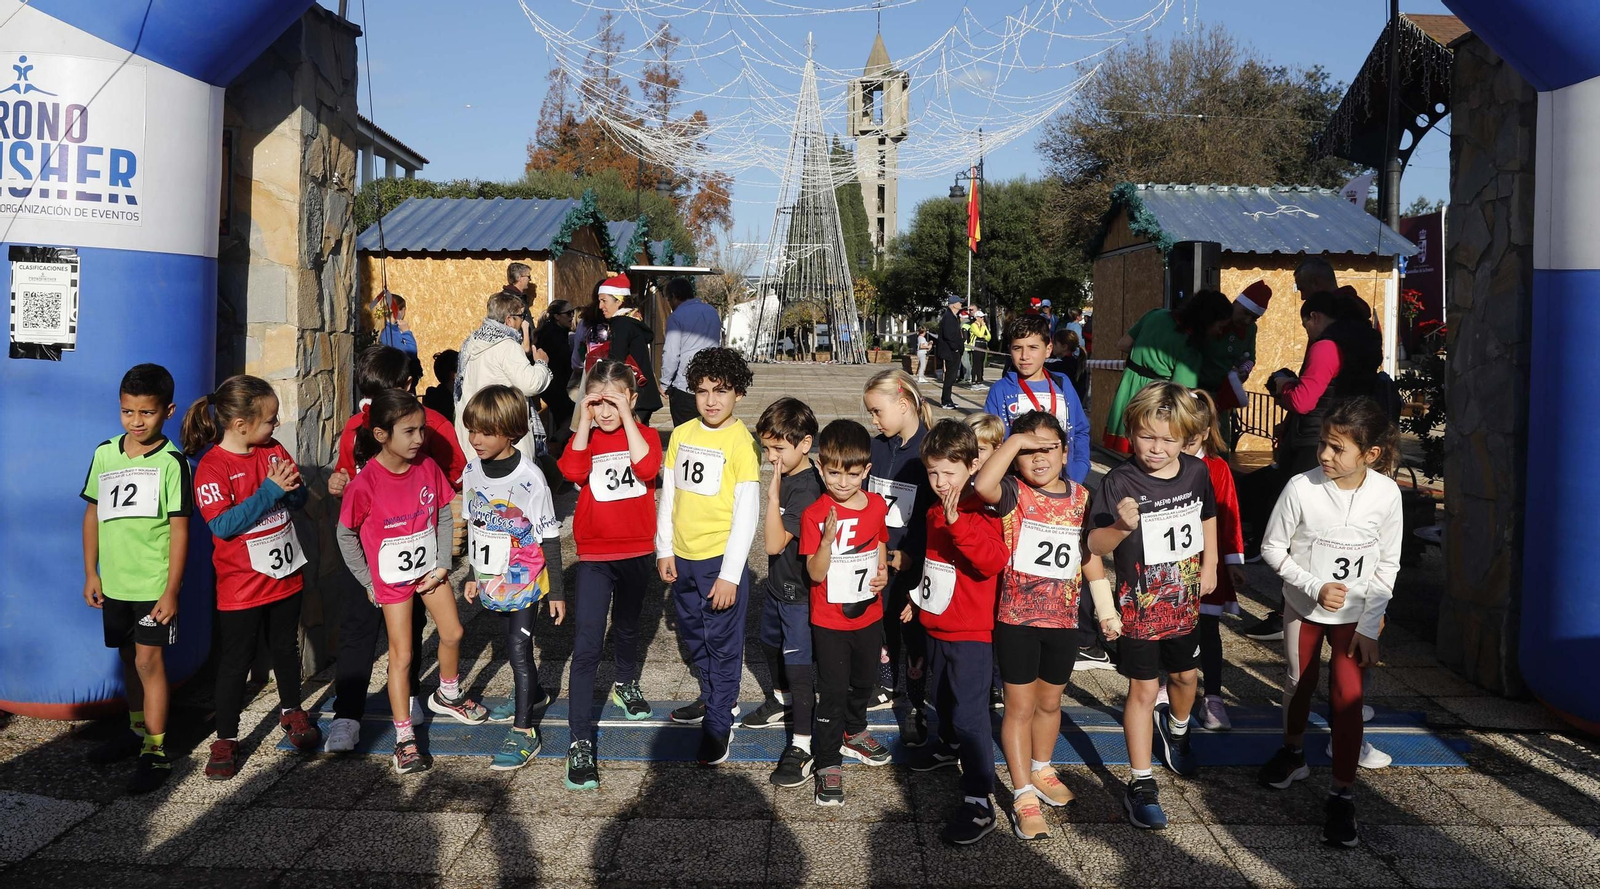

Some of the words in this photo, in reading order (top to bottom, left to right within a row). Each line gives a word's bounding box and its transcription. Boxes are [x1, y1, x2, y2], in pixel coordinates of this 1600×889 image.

[0, 204, 71, 216] ORGANIZACIÓN
[75, 208, 88, 218] DE
[92, 208, 140, 221] EVENTOS
[606, 466, 635, 490] 34
[682, 460, 704, 484] 18
[110, 483, 138, 508] 12
[878, 492, 898, 515] 7
[256, 512, 285, 527] RUNNING
[1025, 524, 1051, 533] CASTELLAR
[1164, 524, 1192, 551] 13
[1316, 540, 1345, 550] CASTELLAR
[269, 542, 294, 570] 30
[398, 546, 427, 571] 32
[472, 540, 490, 565] 11
[1034, 541, 1071, 568] 26
[1332, 555, 1364, 580] 31
[854, 568, 868, 592] 7
[923, 576, 931, 600] 8
